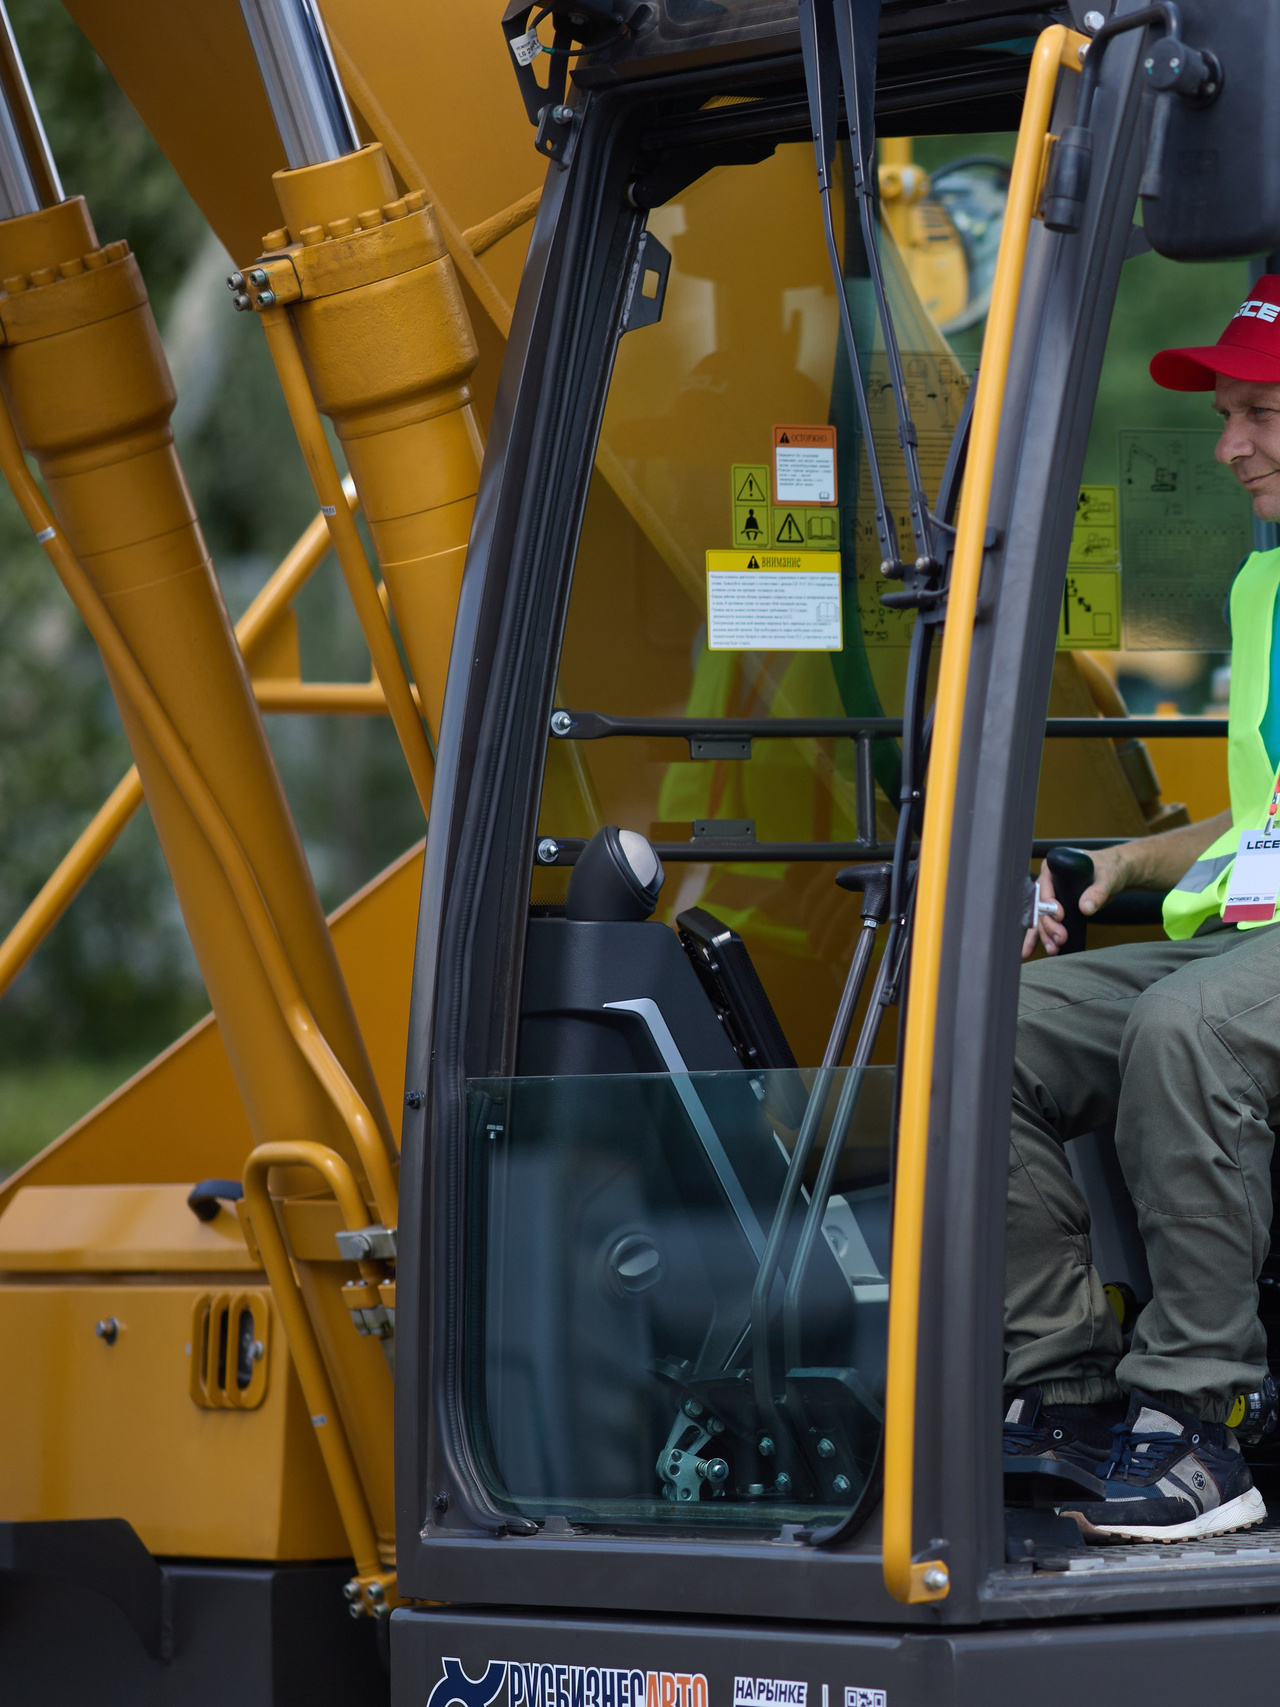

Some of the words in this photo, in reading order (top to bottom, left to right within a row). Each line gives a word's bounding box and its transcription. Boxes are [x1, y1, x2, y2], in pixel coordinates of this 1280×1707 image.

[1246, 840, 1280, 849] LGCE
[735, 1679, 754, 1700] НА
[757, 1681, 806, 1704] РЫНКЕ
